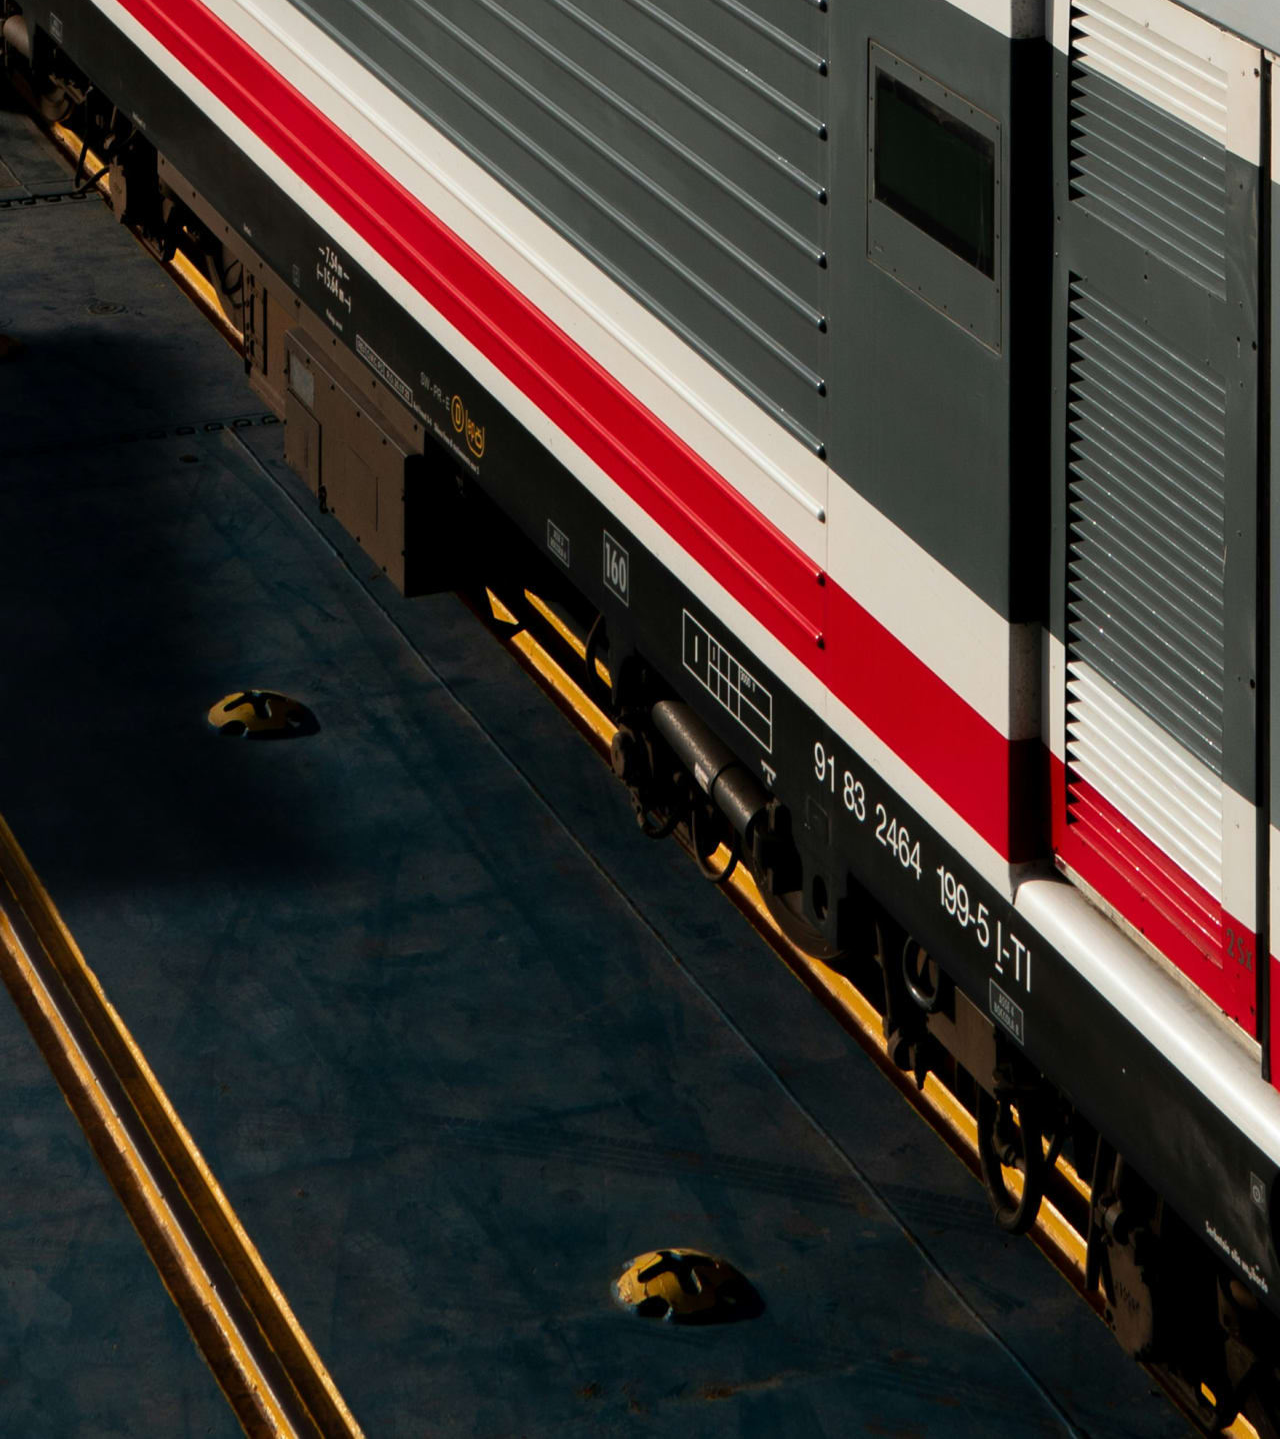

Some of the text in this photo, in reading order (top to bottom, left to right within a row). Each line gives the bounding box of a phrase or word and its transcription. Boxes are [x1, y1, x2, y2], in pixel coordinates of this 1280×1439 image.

[605, 542, 627, 594] 160
[814, 742, 835, 793] 91
[843, 770, 866, 821] 83
[875, 803, 922, 880] 2464
[936, 865, 990, 948] 199-5
